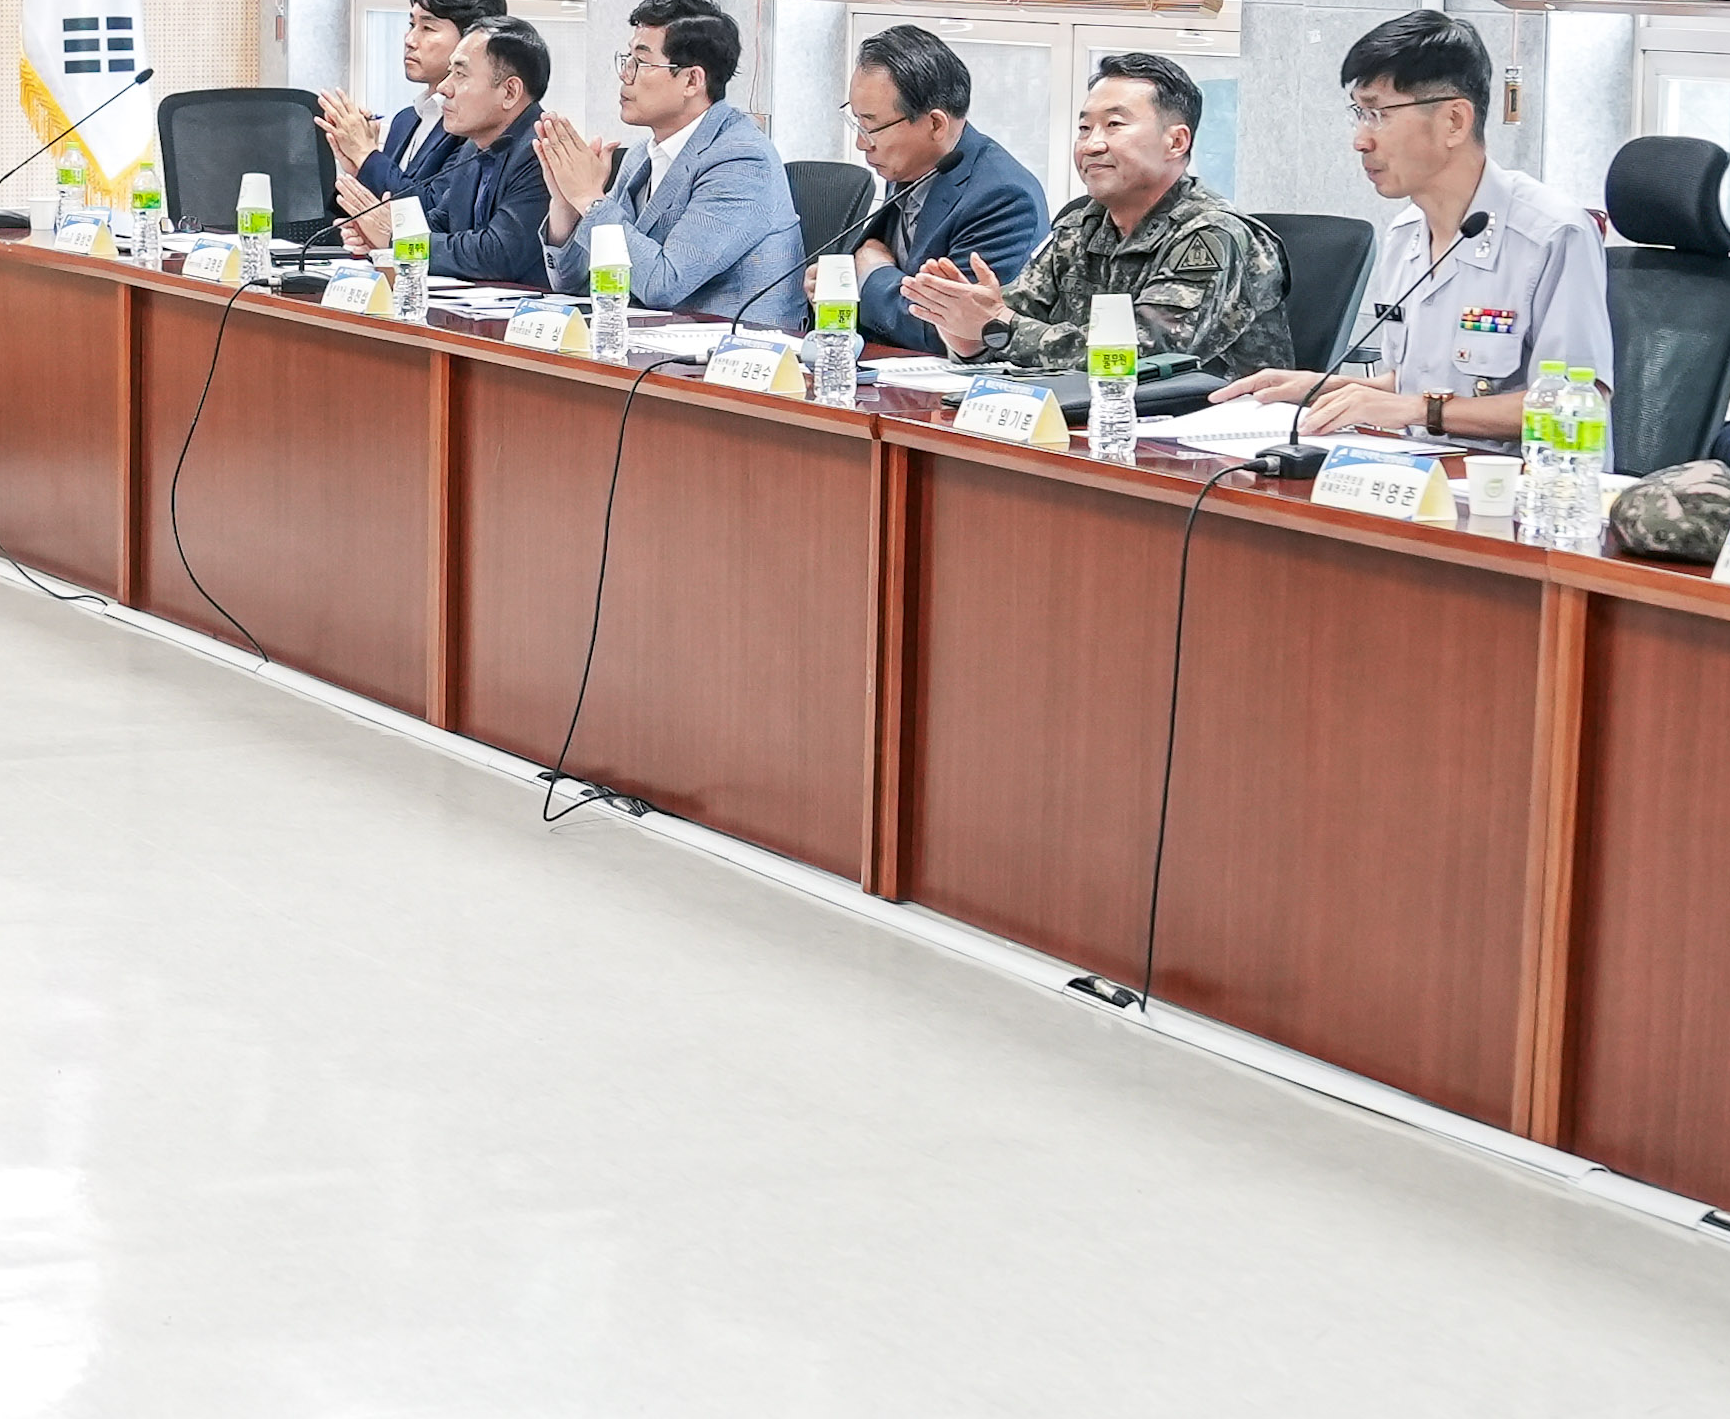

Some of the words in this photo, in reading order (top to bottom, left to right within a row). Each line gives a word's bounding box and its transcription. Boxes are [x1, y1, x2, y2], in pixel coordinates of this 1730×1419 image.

[1103, 353, 1127, 370] 풀무원
[997, 408, 1034, 432] 임기훈
[1370, 478, 1418, 508] 박영준
